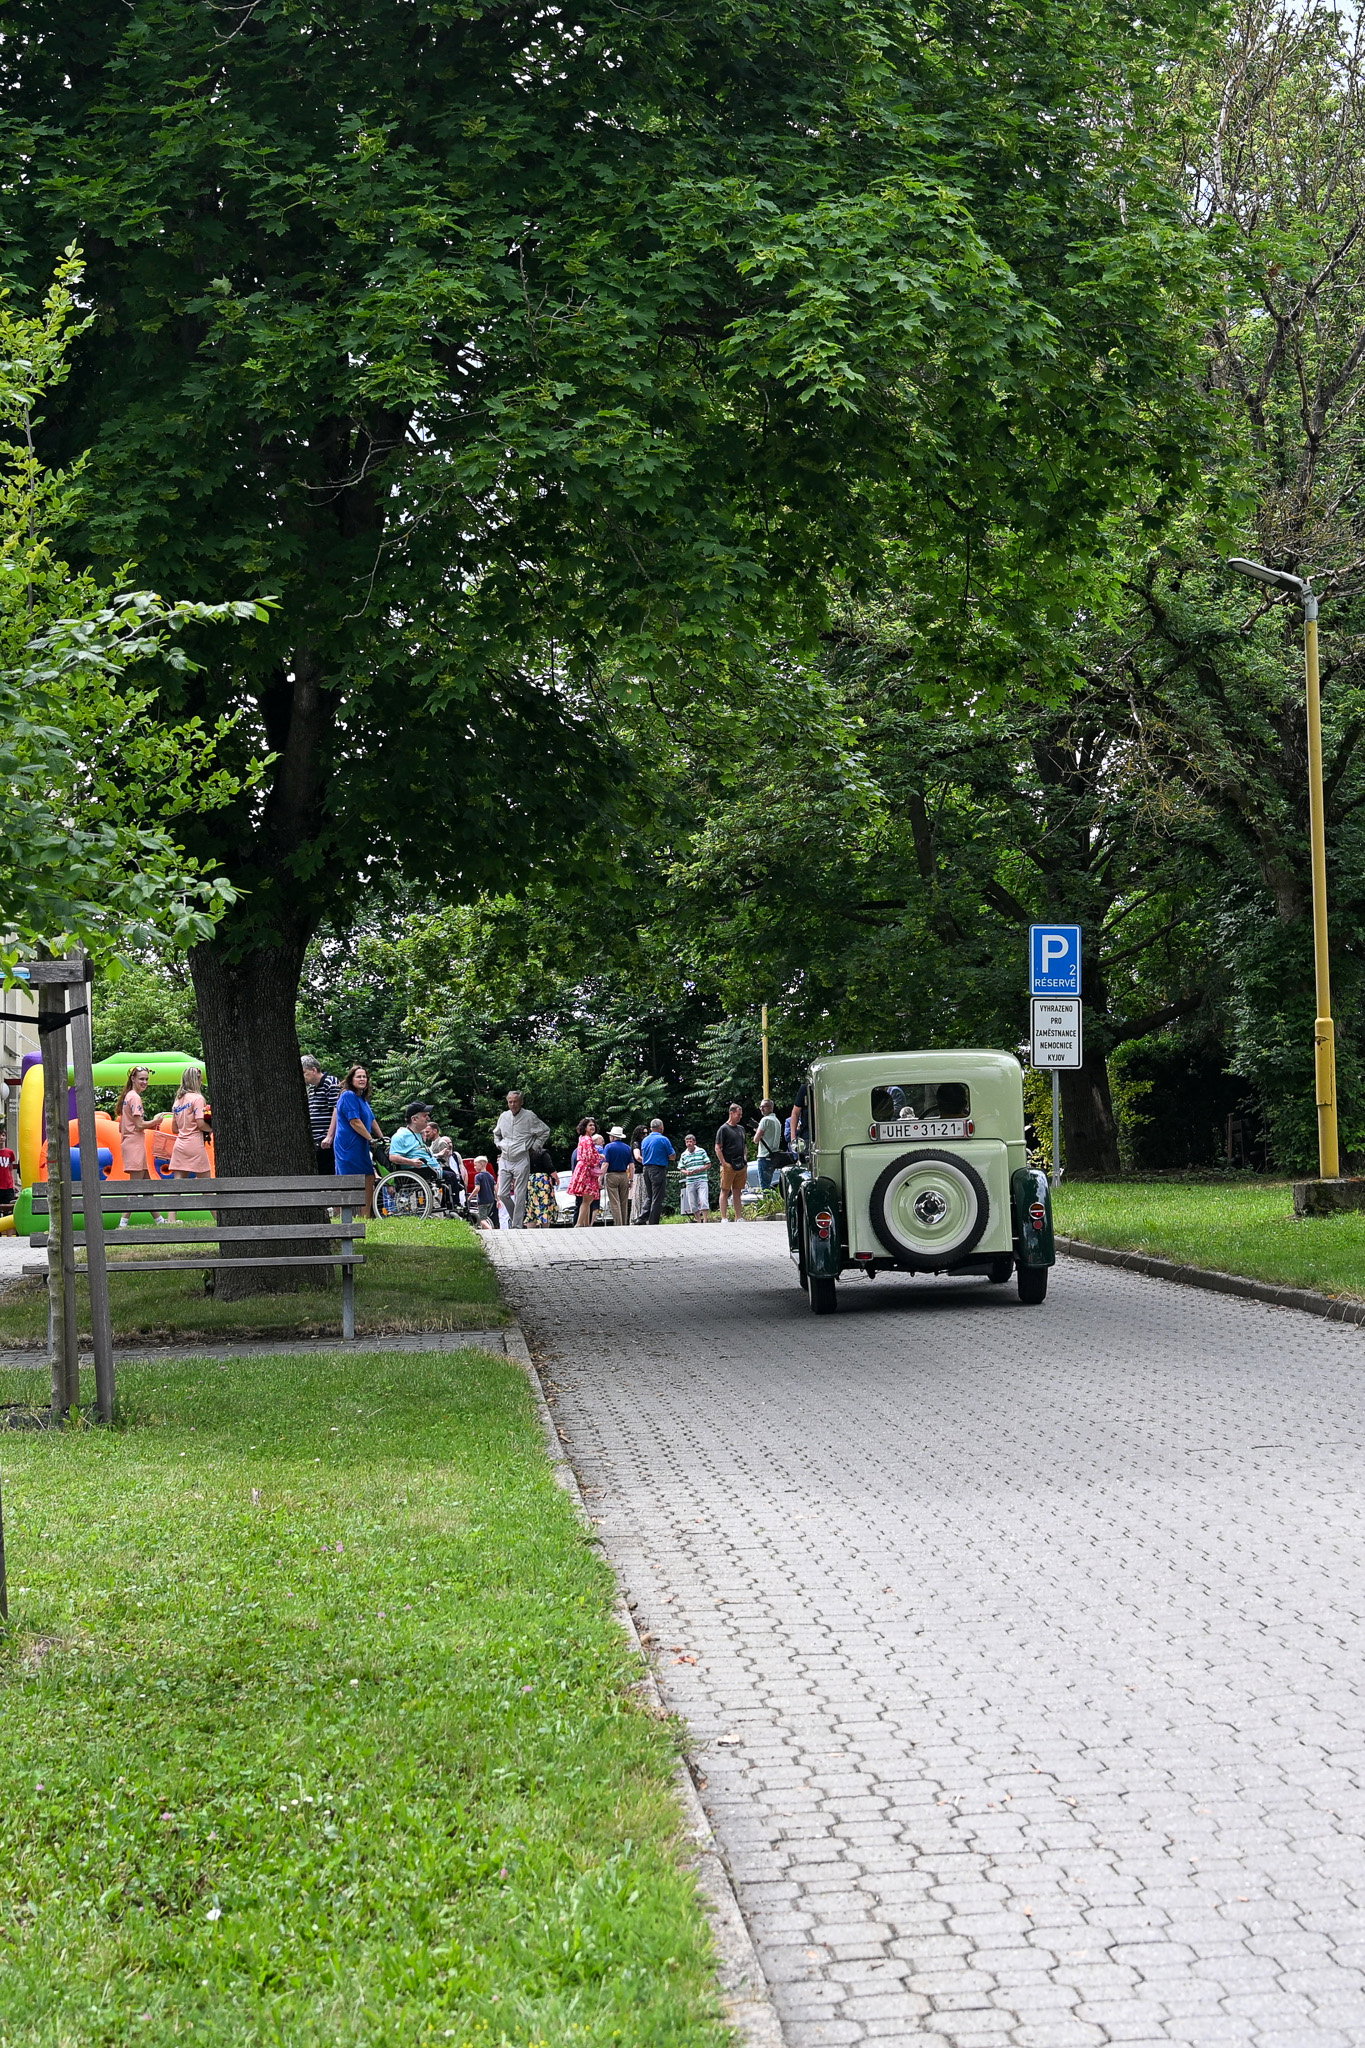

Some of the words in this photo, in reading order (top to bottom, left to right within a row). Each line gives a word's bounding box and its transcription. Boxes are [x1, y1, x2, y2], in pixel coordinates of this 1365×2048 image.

[1041, 934, 1069, 974] P
[1069, 964, 1076, 976] 2
[1034, 976, 1076, 988] RÉSERVÉ
[1039, 1004, 1074, 1013] VYHRAZENO
[1050, 1017, 1063, 1025] PRO
[1035, 1028, 1077, 1038] ZAMĚSTNANCE
[1039, 1041, 1073, 1050] NEMOCNICE
[1047, 1053, 1066, 1062] KYJOV
[886, 1124, 912, 1138] UHE
[921, 1122, 957, 1137] 31-21
